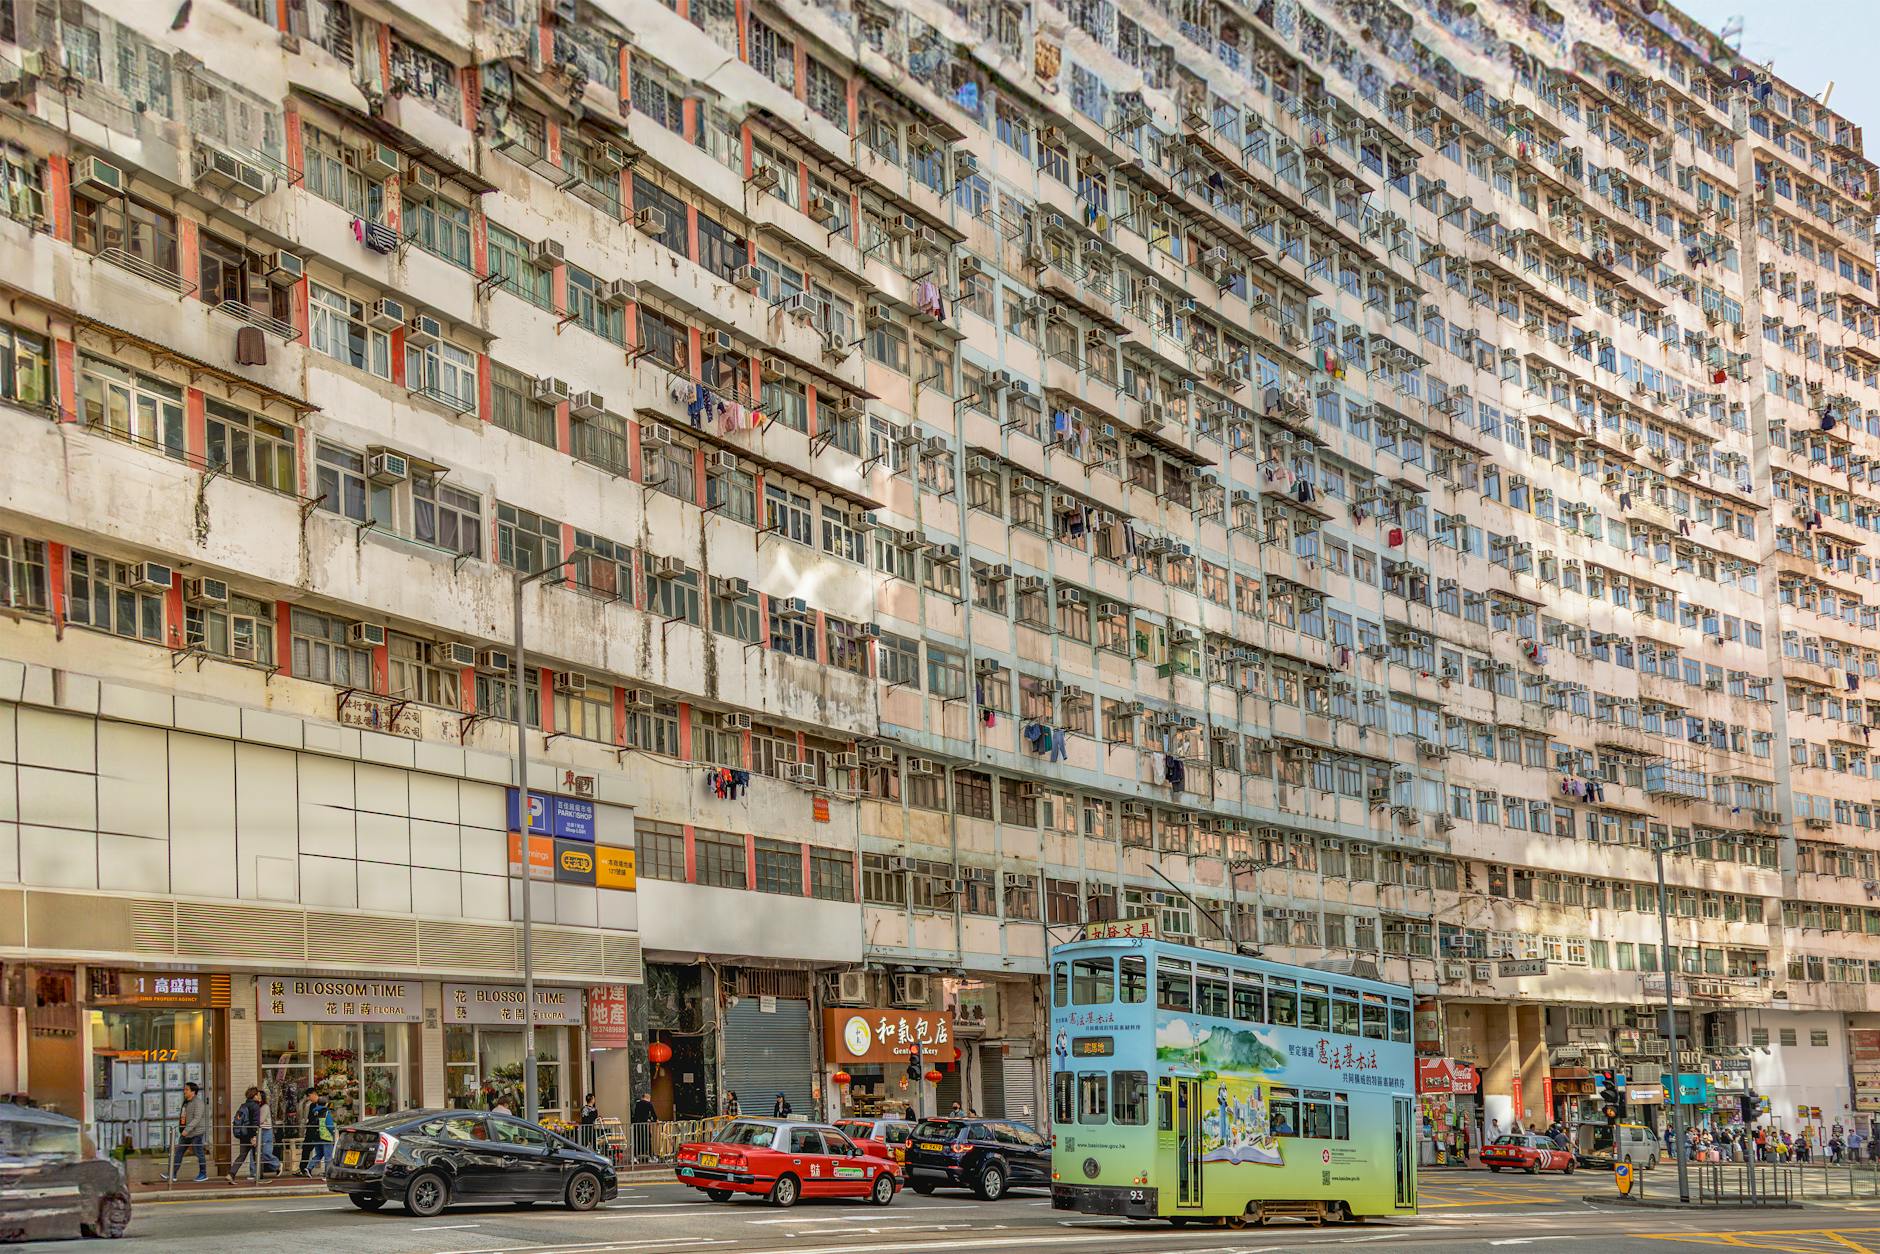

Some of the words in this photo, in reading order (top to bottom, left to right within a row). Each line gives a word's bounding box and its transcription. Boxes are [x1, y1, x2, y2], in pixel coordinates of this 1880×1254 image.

[294, 981, 368, 997] BLOSSOM
[370, 983, 406, 997] TIME
[476, 989, 534, 1003] BLOSSO
[536, 992, 567, 1005] TIME
[874, 1015, 948, 1045] 和氣包店
[142, 1049, 178, 1062] 1127
[1315, 1037, 1378, 1071] 憲法基本法
[1130, 1190, 1144, 1201] 93
